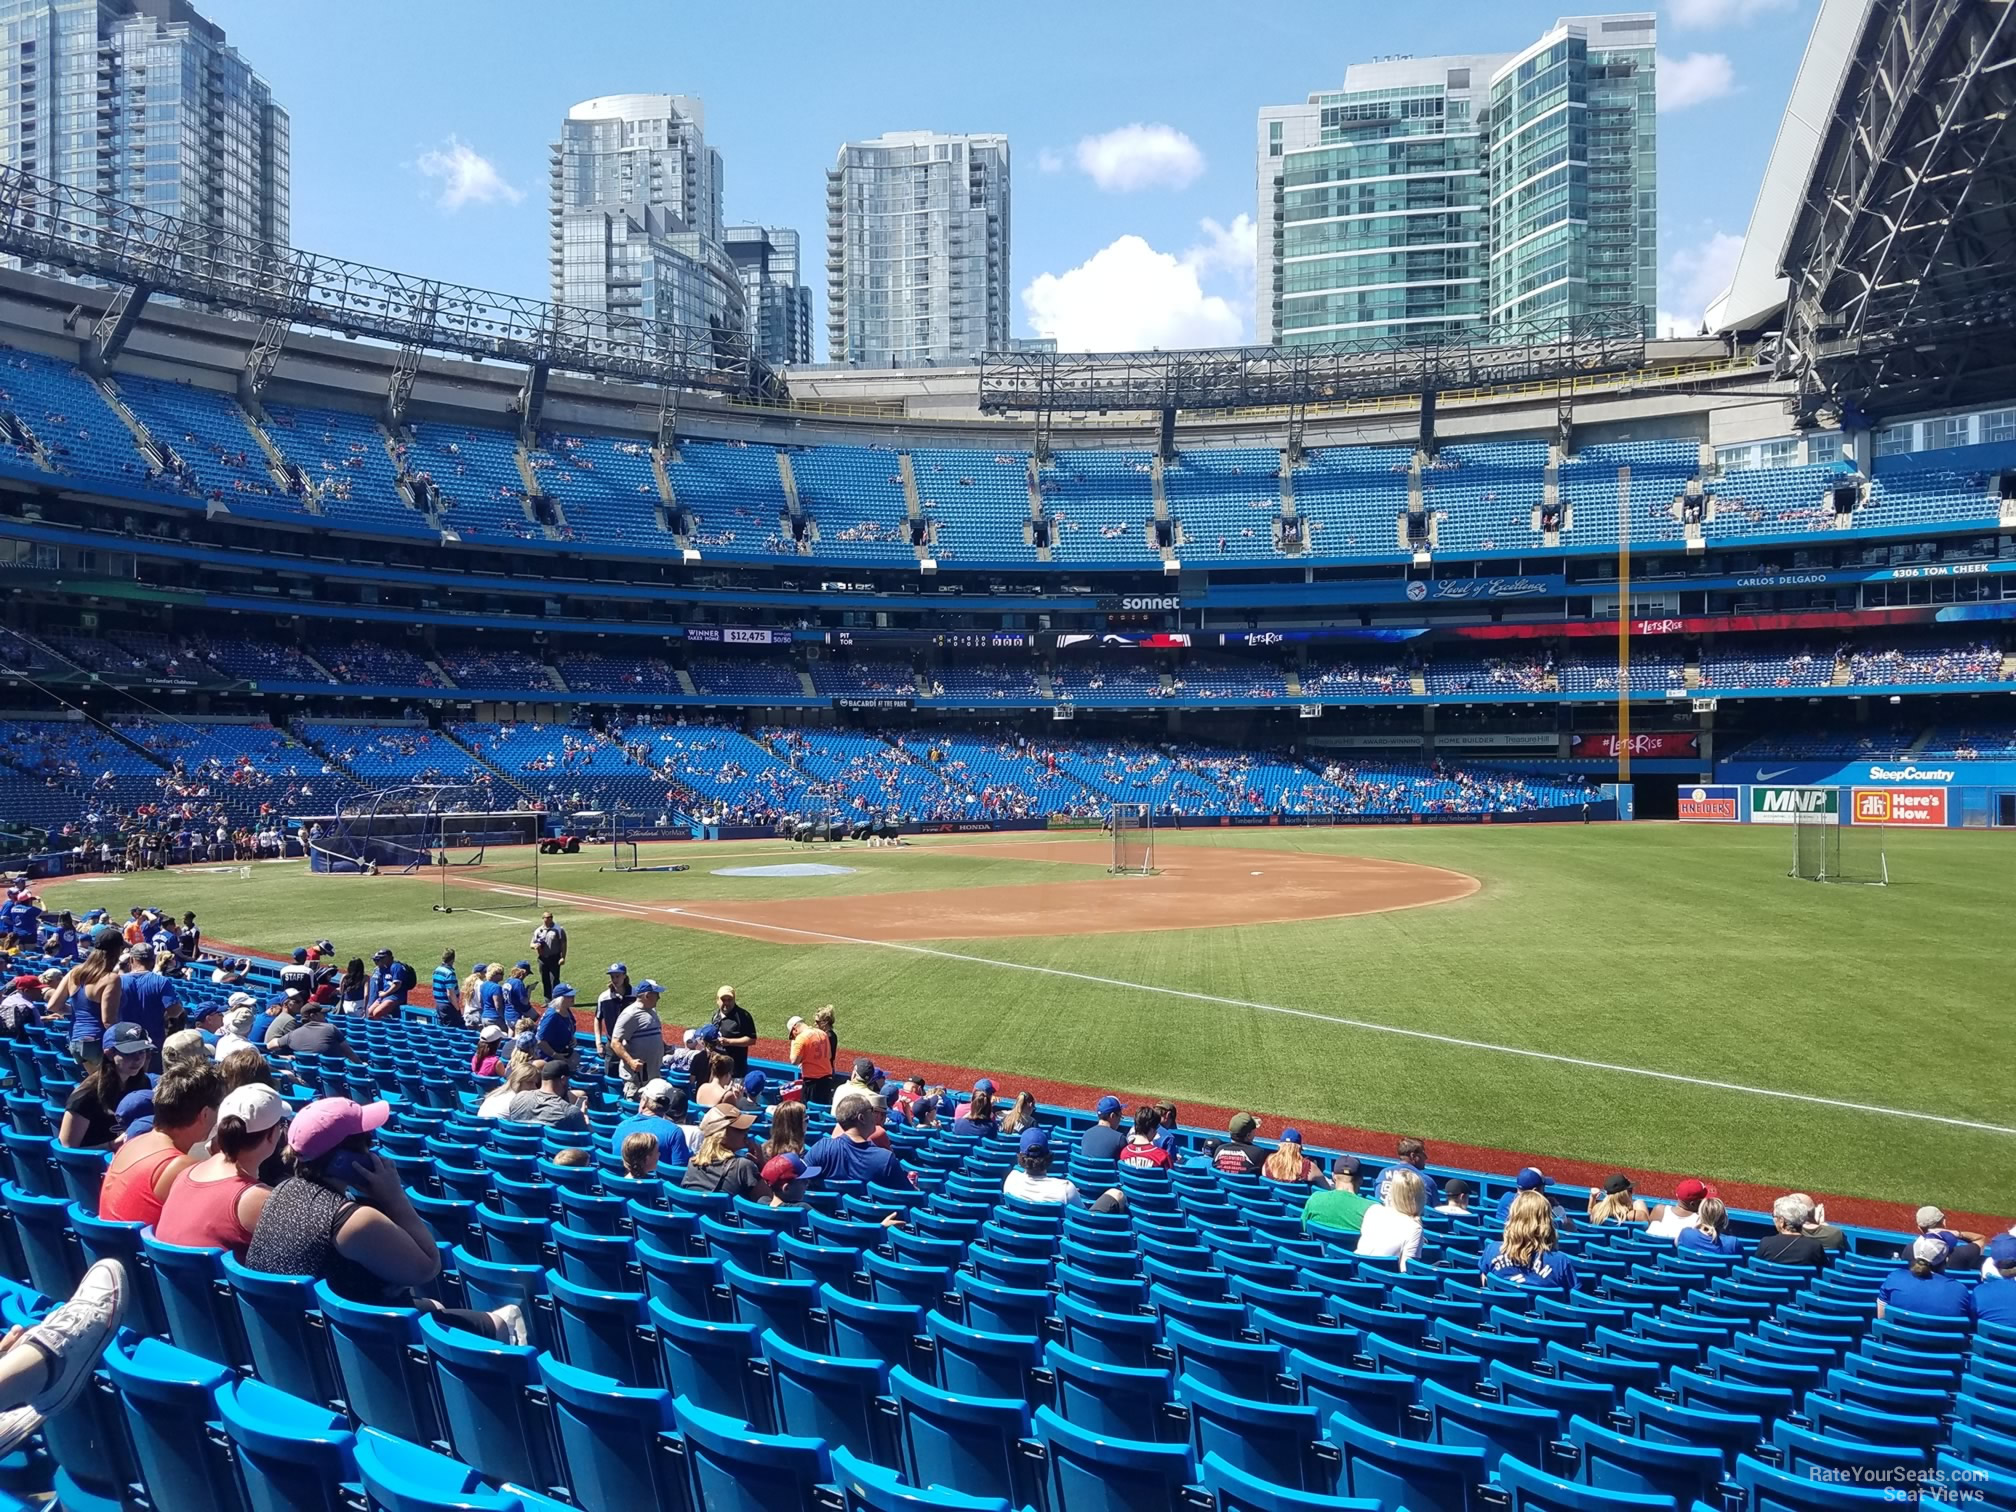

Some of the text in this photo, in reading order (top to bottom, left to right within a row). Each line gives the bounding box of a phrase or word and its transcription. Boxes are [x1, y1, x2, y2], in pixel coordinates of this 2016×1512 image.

[1892, 562, 1989, 578] 4306 TOM CHEEK
[1737, 574, 1827, 587] CARLOS DELGADO
[1122, 597, 1180, 610] sonnet
[688, 629, 720, 637] WINNER
[730, 631, 766, 642] $12,475
[1762, 790, 1828, 812] MNP
[1893, 793, 1939, 806] Here's
[1893, 808, 1930, 820] How.
[285, 972, 305, 981] STAFF
